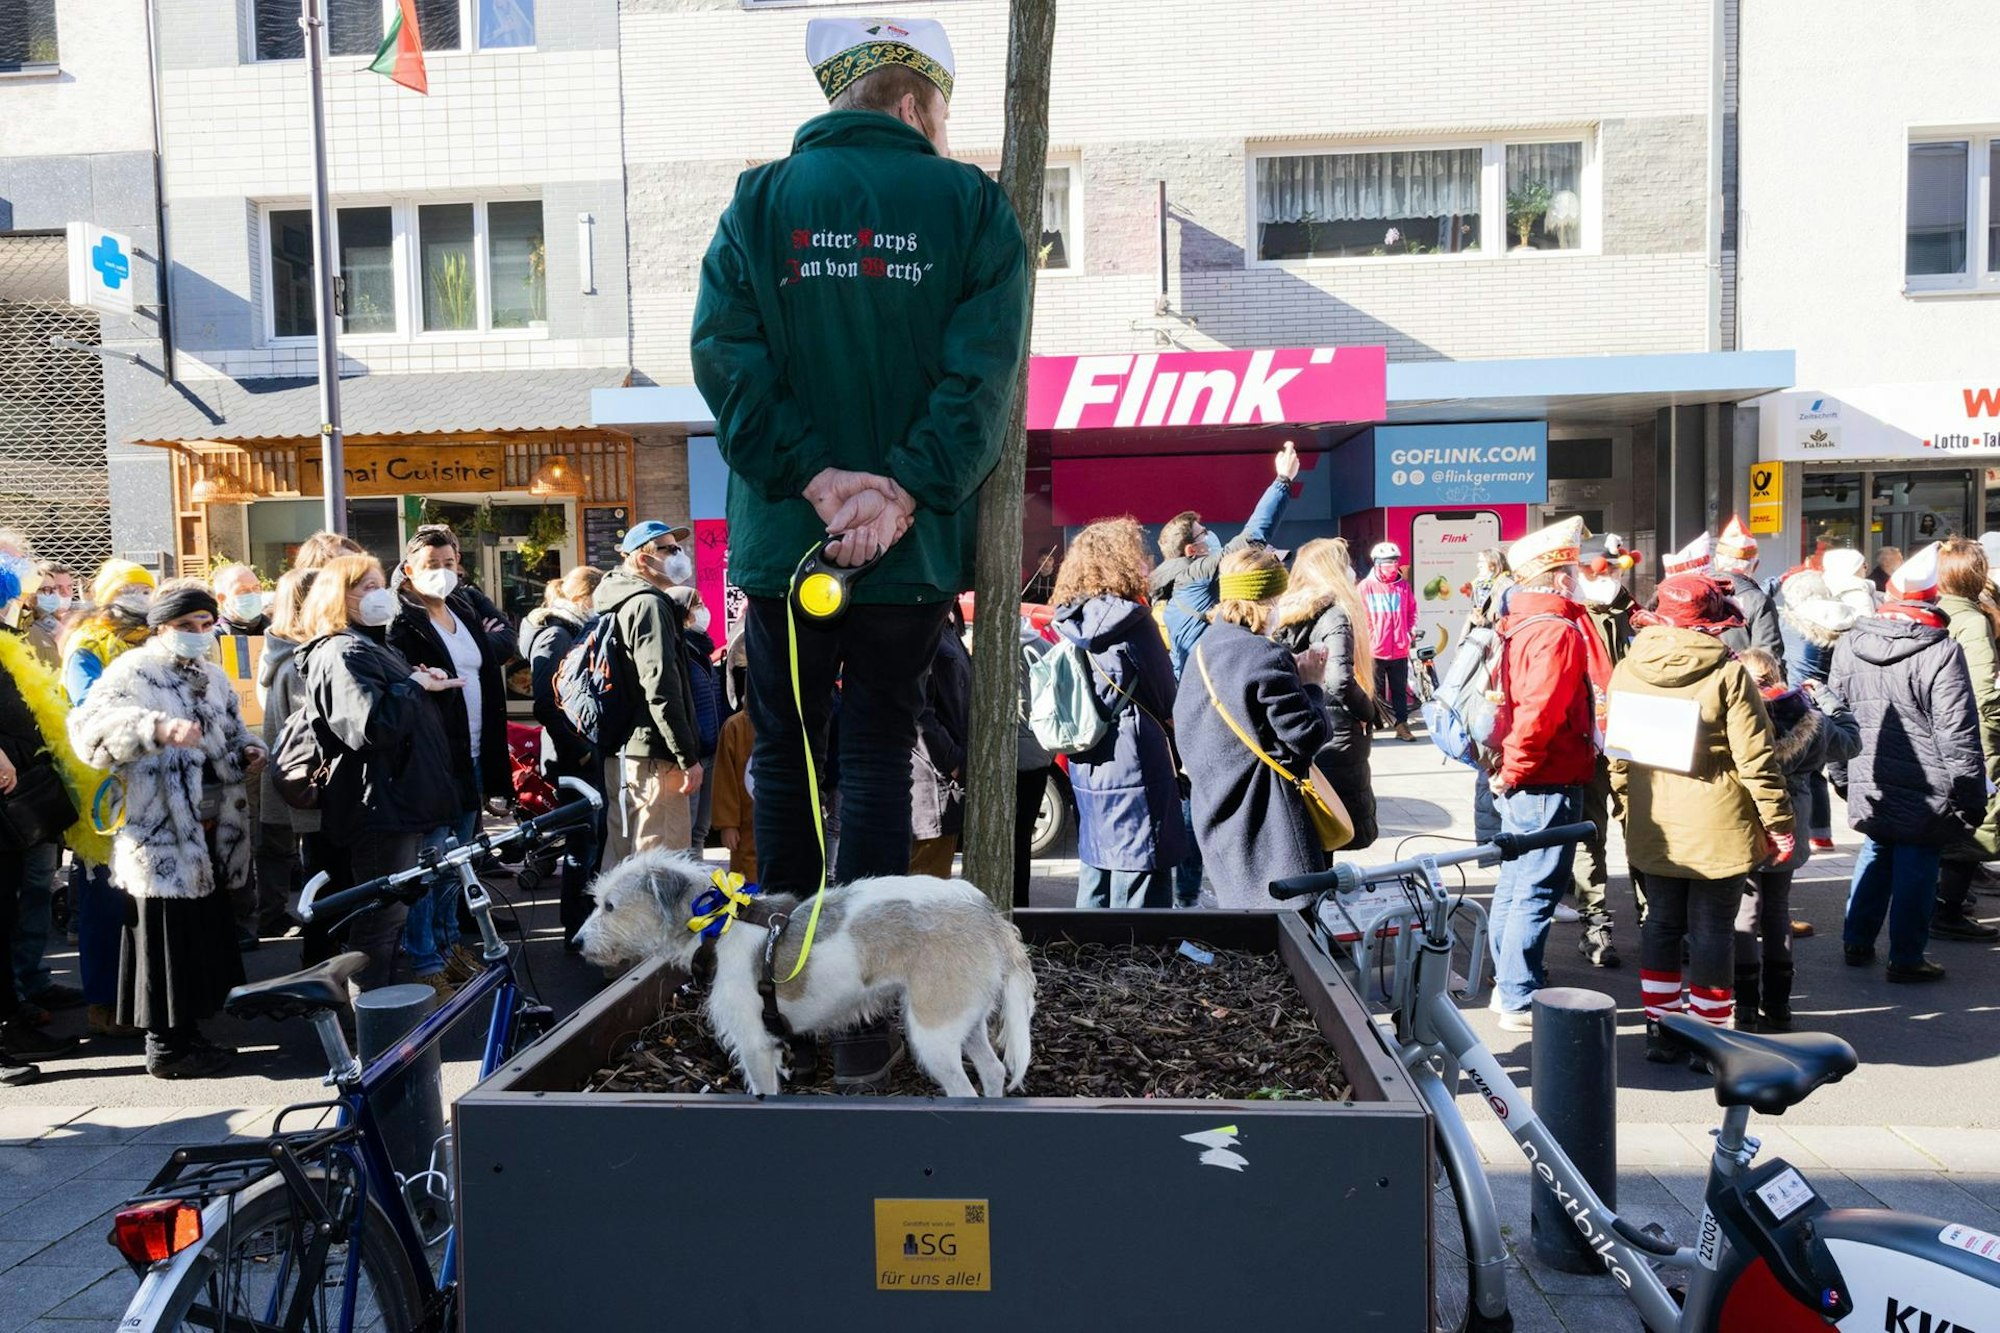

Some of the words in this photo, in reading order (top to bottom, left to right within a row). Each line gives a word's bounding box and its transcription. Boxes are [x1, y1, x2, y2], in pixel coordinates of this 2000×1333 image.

[825, 257, 858, 278] von
[1053, 349, 1304, 429] Flink
[1799, 411, 1838, 420] Zeitschrift
[1802, 441, 1836, 449] Tabak
[1934, 433, 1969, 449] Lotto
[1391, 446, 1536, 465] GOFLINK.COM
[386, 457, 496, 482] Cuisine
[1432, 469, 1535, 485] @flinkgermany
[1441, 533, 1469, 544] Flink
[1469, 1068, 1493, 1097] KVB
[1521, 1140, 1632, 1290] nextbike
[1699, 1213, 1718, 1261] 221003
[881, 1270, 906, 1285] für
[911, 1274, 940, 1285] uns
[945, 1271, 982, 1286] alle!
[1885, 1296, 1975, 1333] KV
